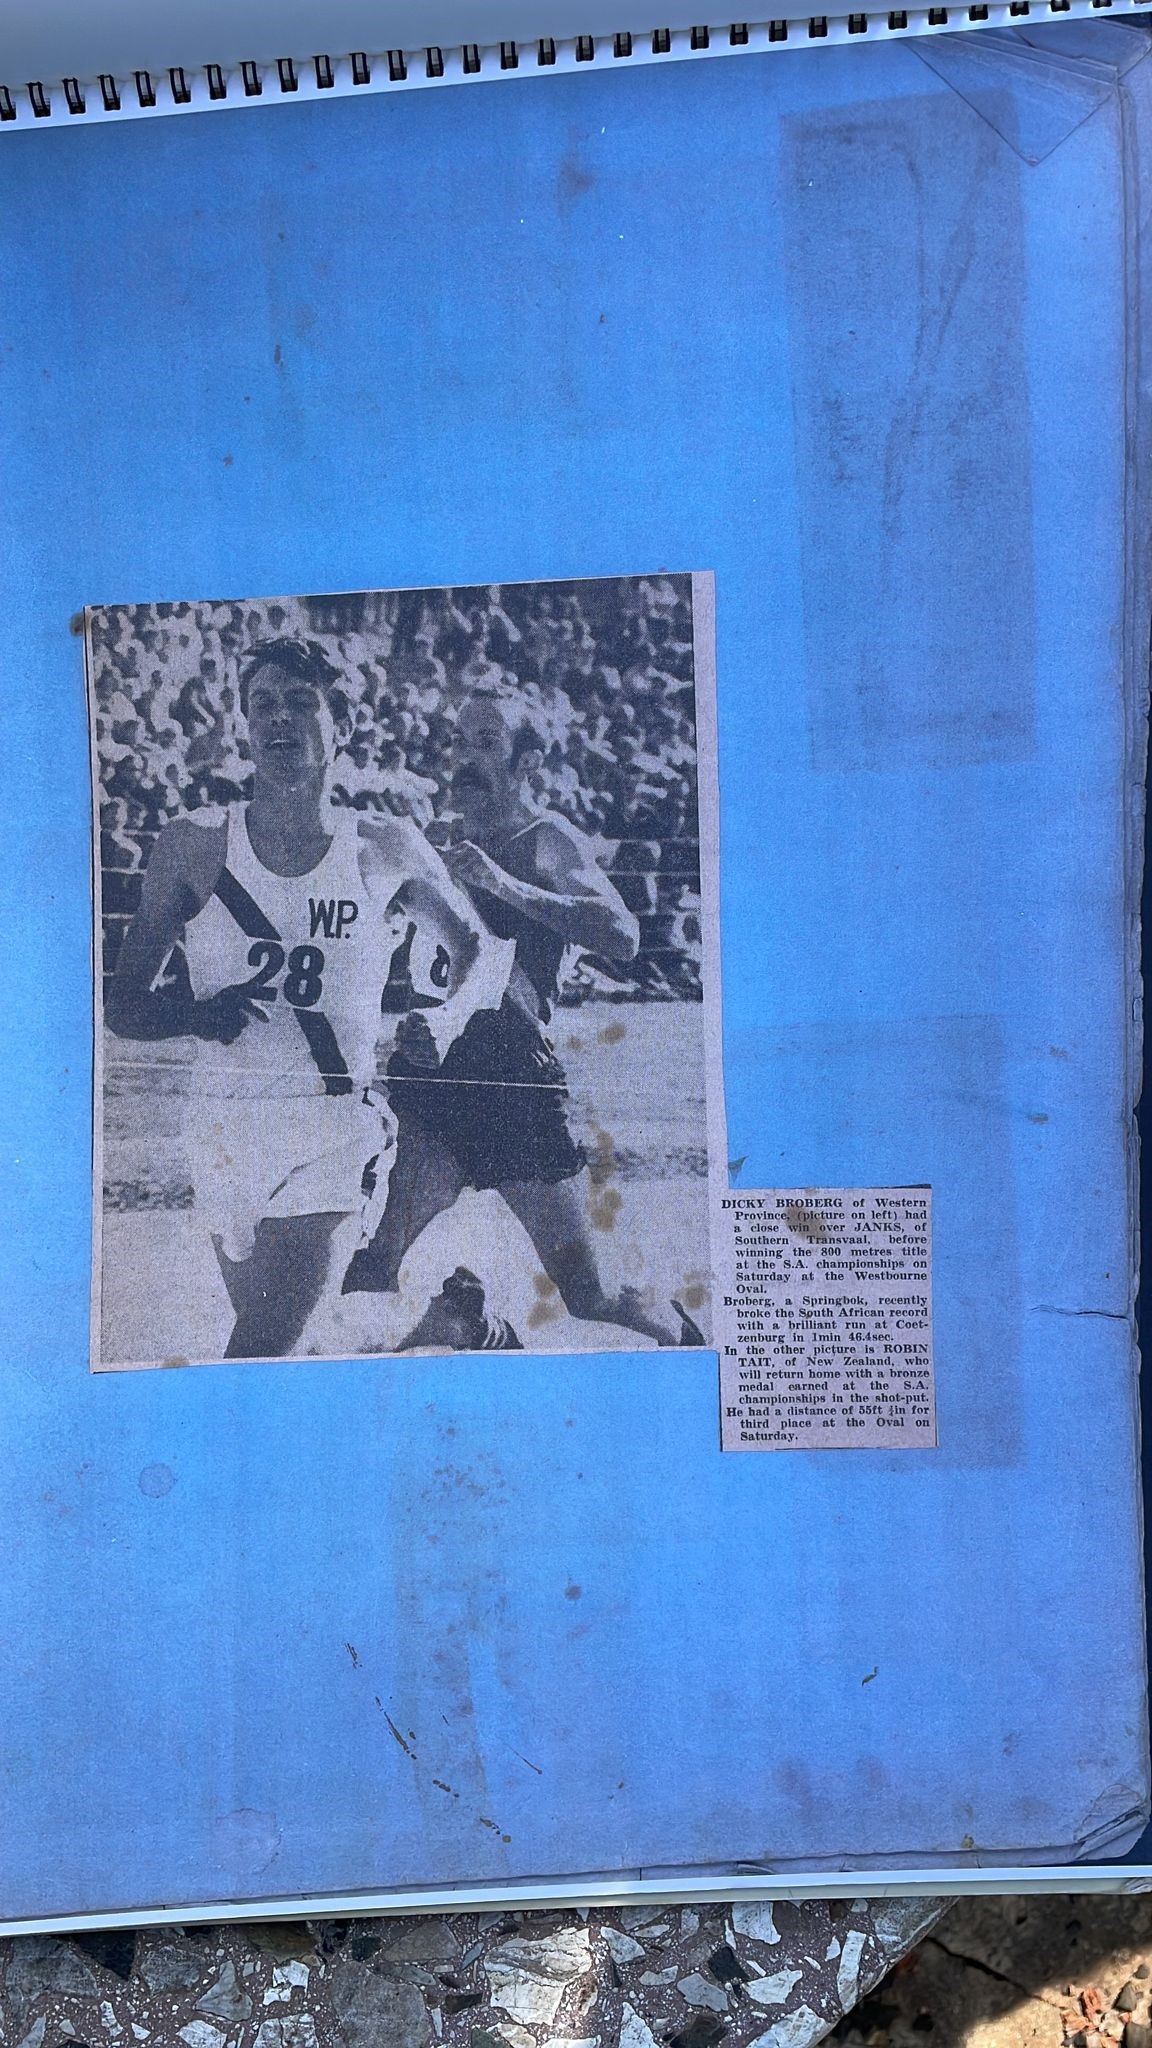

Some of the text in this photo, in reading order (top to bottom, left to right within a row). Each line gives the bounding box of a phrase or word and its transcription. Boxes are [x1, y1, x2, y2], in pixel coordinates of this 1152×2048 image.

[248, 941, 325, 1007] 28
[721, 1199, 927, 1209] DICKY BROBERG of Western
[735, 1210, 927, 1221] Province, (picture on left) had
[733, 1222, 927, 1233] a close win over JANKS, of
[735, 1235, 789, 1245] Southern
[889, 1235, 927, 1244] before
[735, 1247, 927, 1259] winning the 800 metres title
[735, 1259, 927, 1271] at the S.A. championships on
[736, 1271, 927, 1283] Saturday at the Westbourne
[736, 1285, 767, 1294] Oval.
[723, 1295, 928, 1307] Broberg, a Springbok, recently
[737, 1308, 928, 1318] broke the South African record
[737, 1320, 929, 1330] with a brilliant run at Coet-
[737, 1332, 894, 1344] zenburg in 1min 46.4sec.
[724, 1344, 929, 1356] In the other picture is ROBIN
[738, 1356, 929, 1368] TAIT, of New Zealand, who
[739, 1368, 930, 1380] will return home with a bronze
[738, 1380, 929, 1392] medal earned at the S.A.
[739, 1393, 929, 1405] championships in the shot-put.
[726, 1407, 743, 1417] He
[748, 1406, 770, 1416] had
[774, 1408, 783, 1416] a
[787, 1406, 837, 1416] distance
[841, 1406, 853, 1415] of
[858, 1405, 883, 1415] 55ft
[911, 1405, 930, 1415] for
[740, 1418, 930, 1430] third place at the Oval on
[740, 1431, 798, 1443] Saturday.
